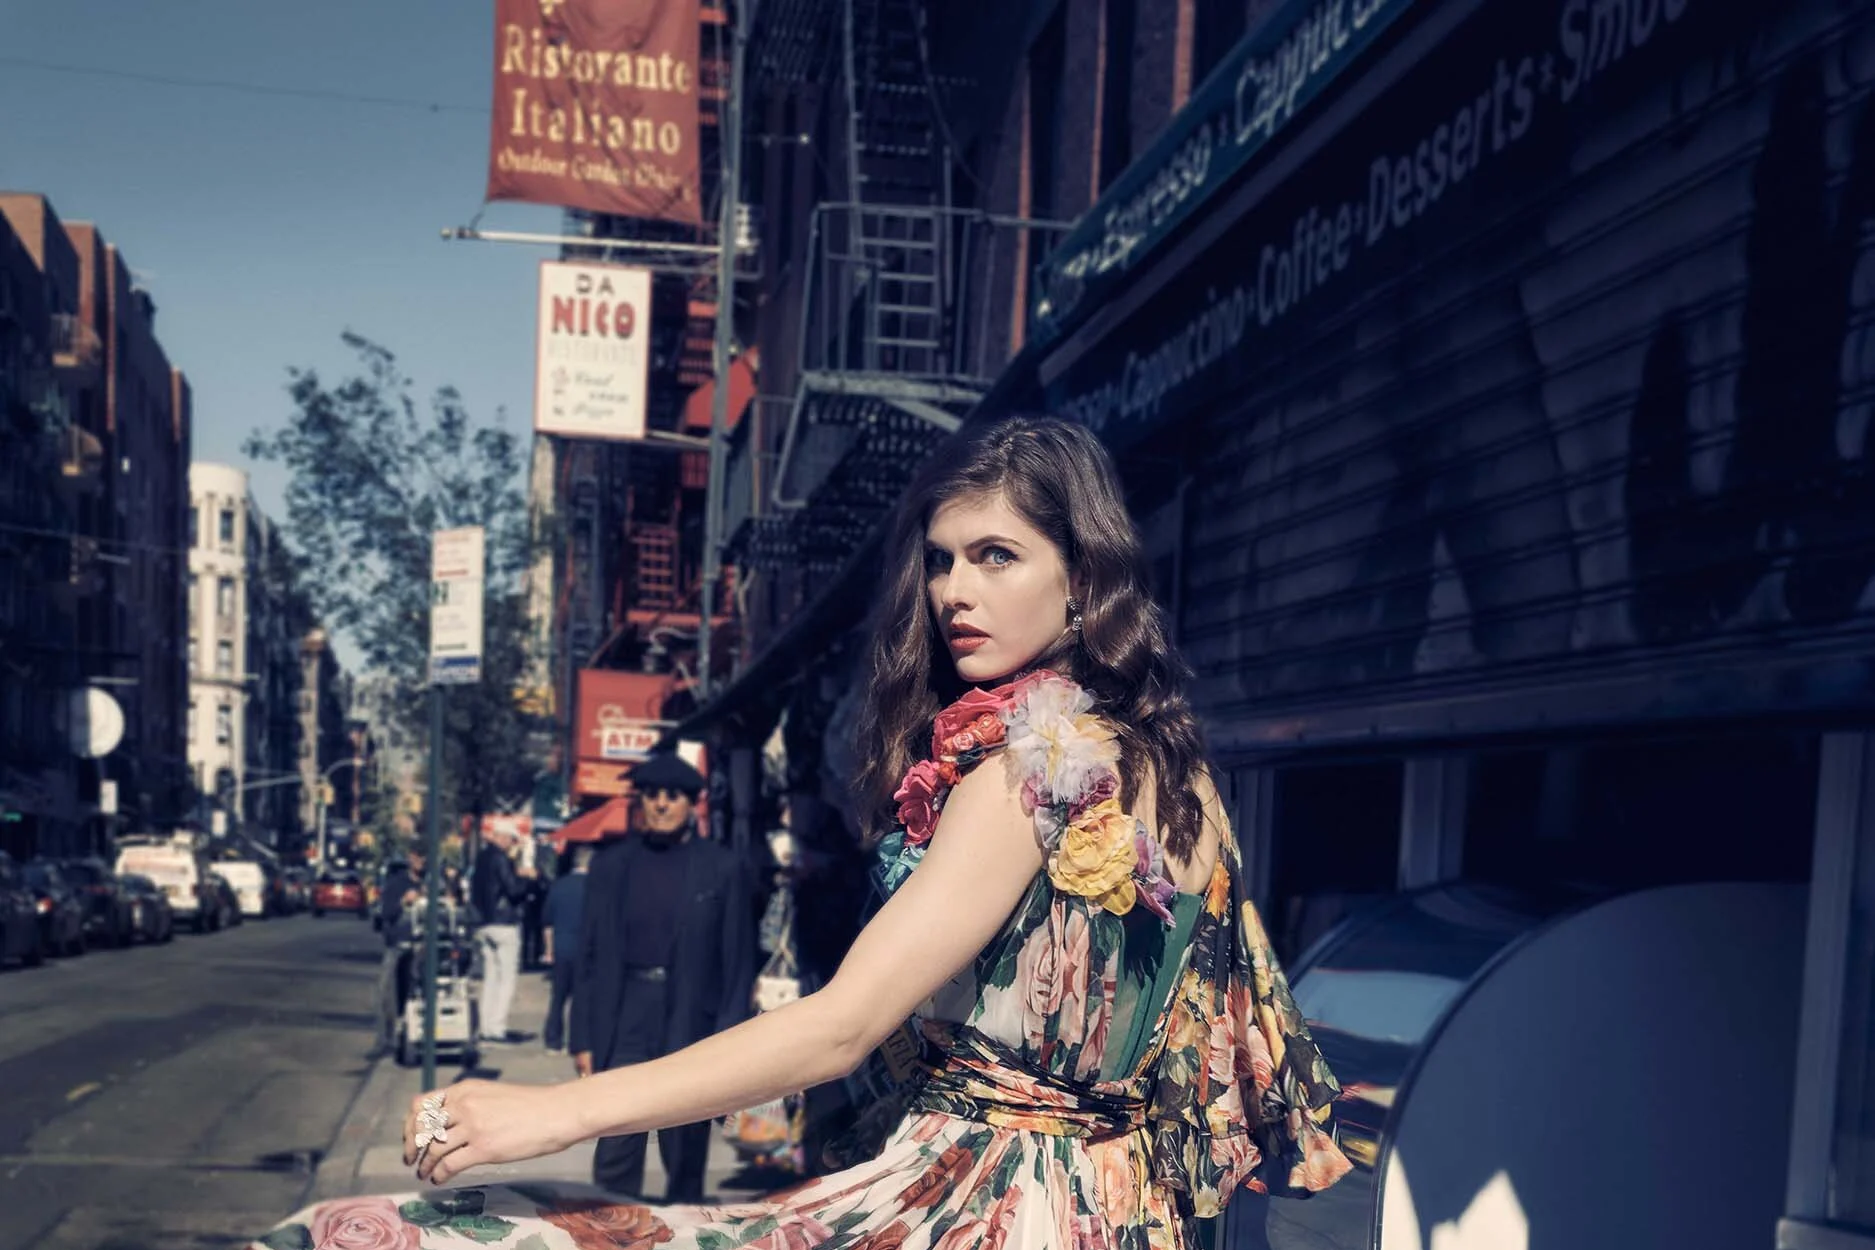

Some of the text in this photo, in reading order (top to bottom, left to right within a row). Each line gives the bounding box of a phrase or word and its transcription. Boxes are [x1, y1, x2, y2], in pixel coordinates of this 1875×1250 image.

[501, 24, 692, 94] Ristorante
[511, 88, 681, 155] Italiano
[1256, 199, 1353, 328] Coffee
[1365, 54, 1535, 248] Desserts
[552, 296, 636, 339] NICO
[606, 731, 653, 748] ATM
